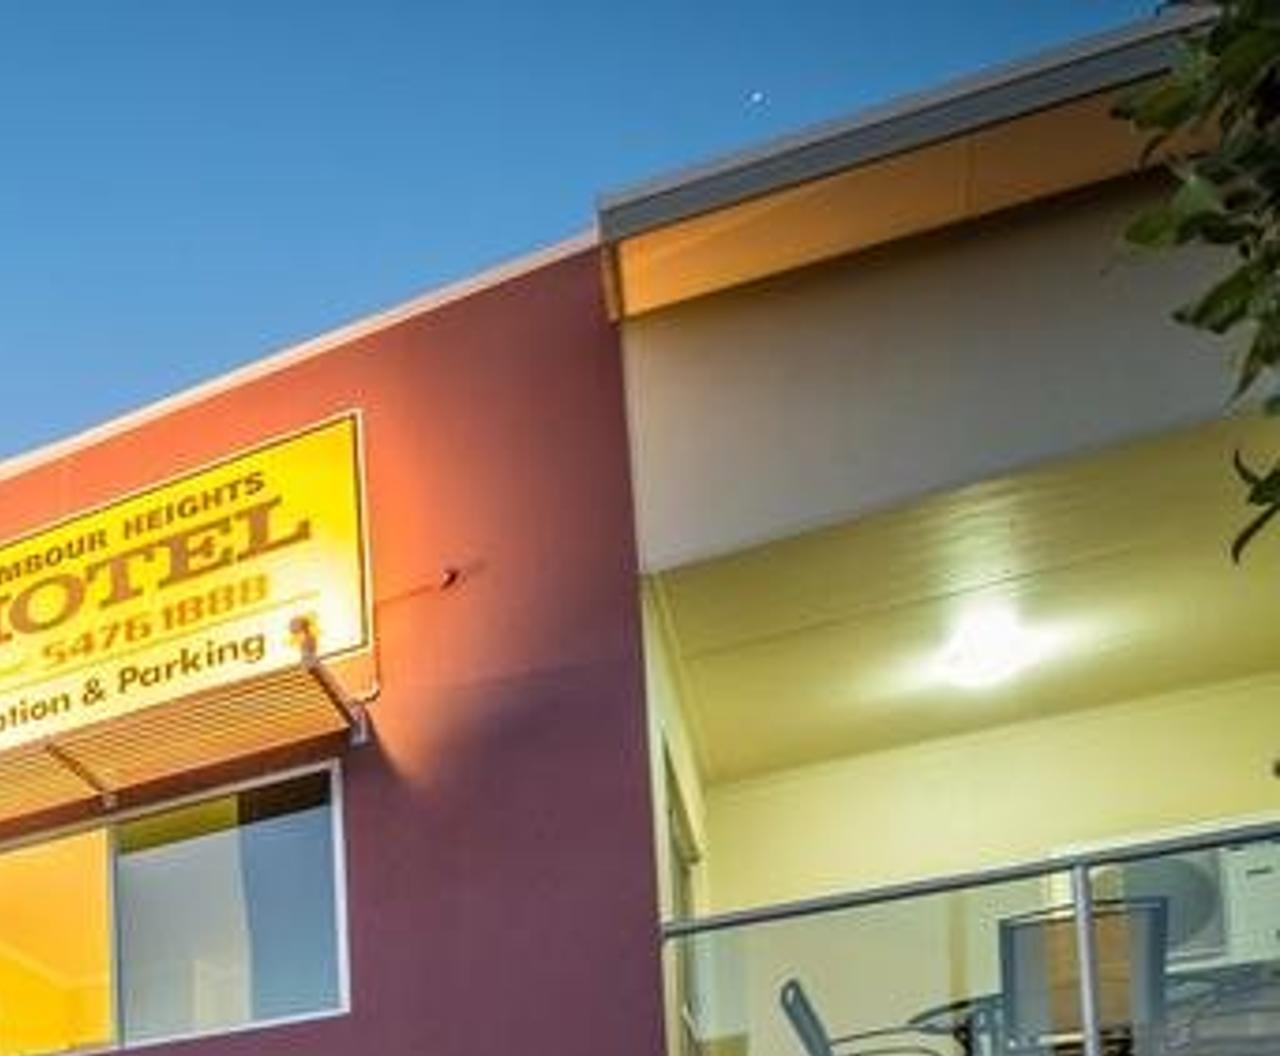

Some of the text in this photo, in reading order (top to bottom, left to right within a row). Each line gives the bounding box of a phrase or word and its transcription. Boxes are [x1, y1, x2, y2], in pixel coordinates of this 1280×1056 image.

[123, 470, 266, 541] HEIGHTS
[42, 609, 152, 665] 5476
[81, 676, 105, 706] &
[117, 632, 267, 694] Parking
